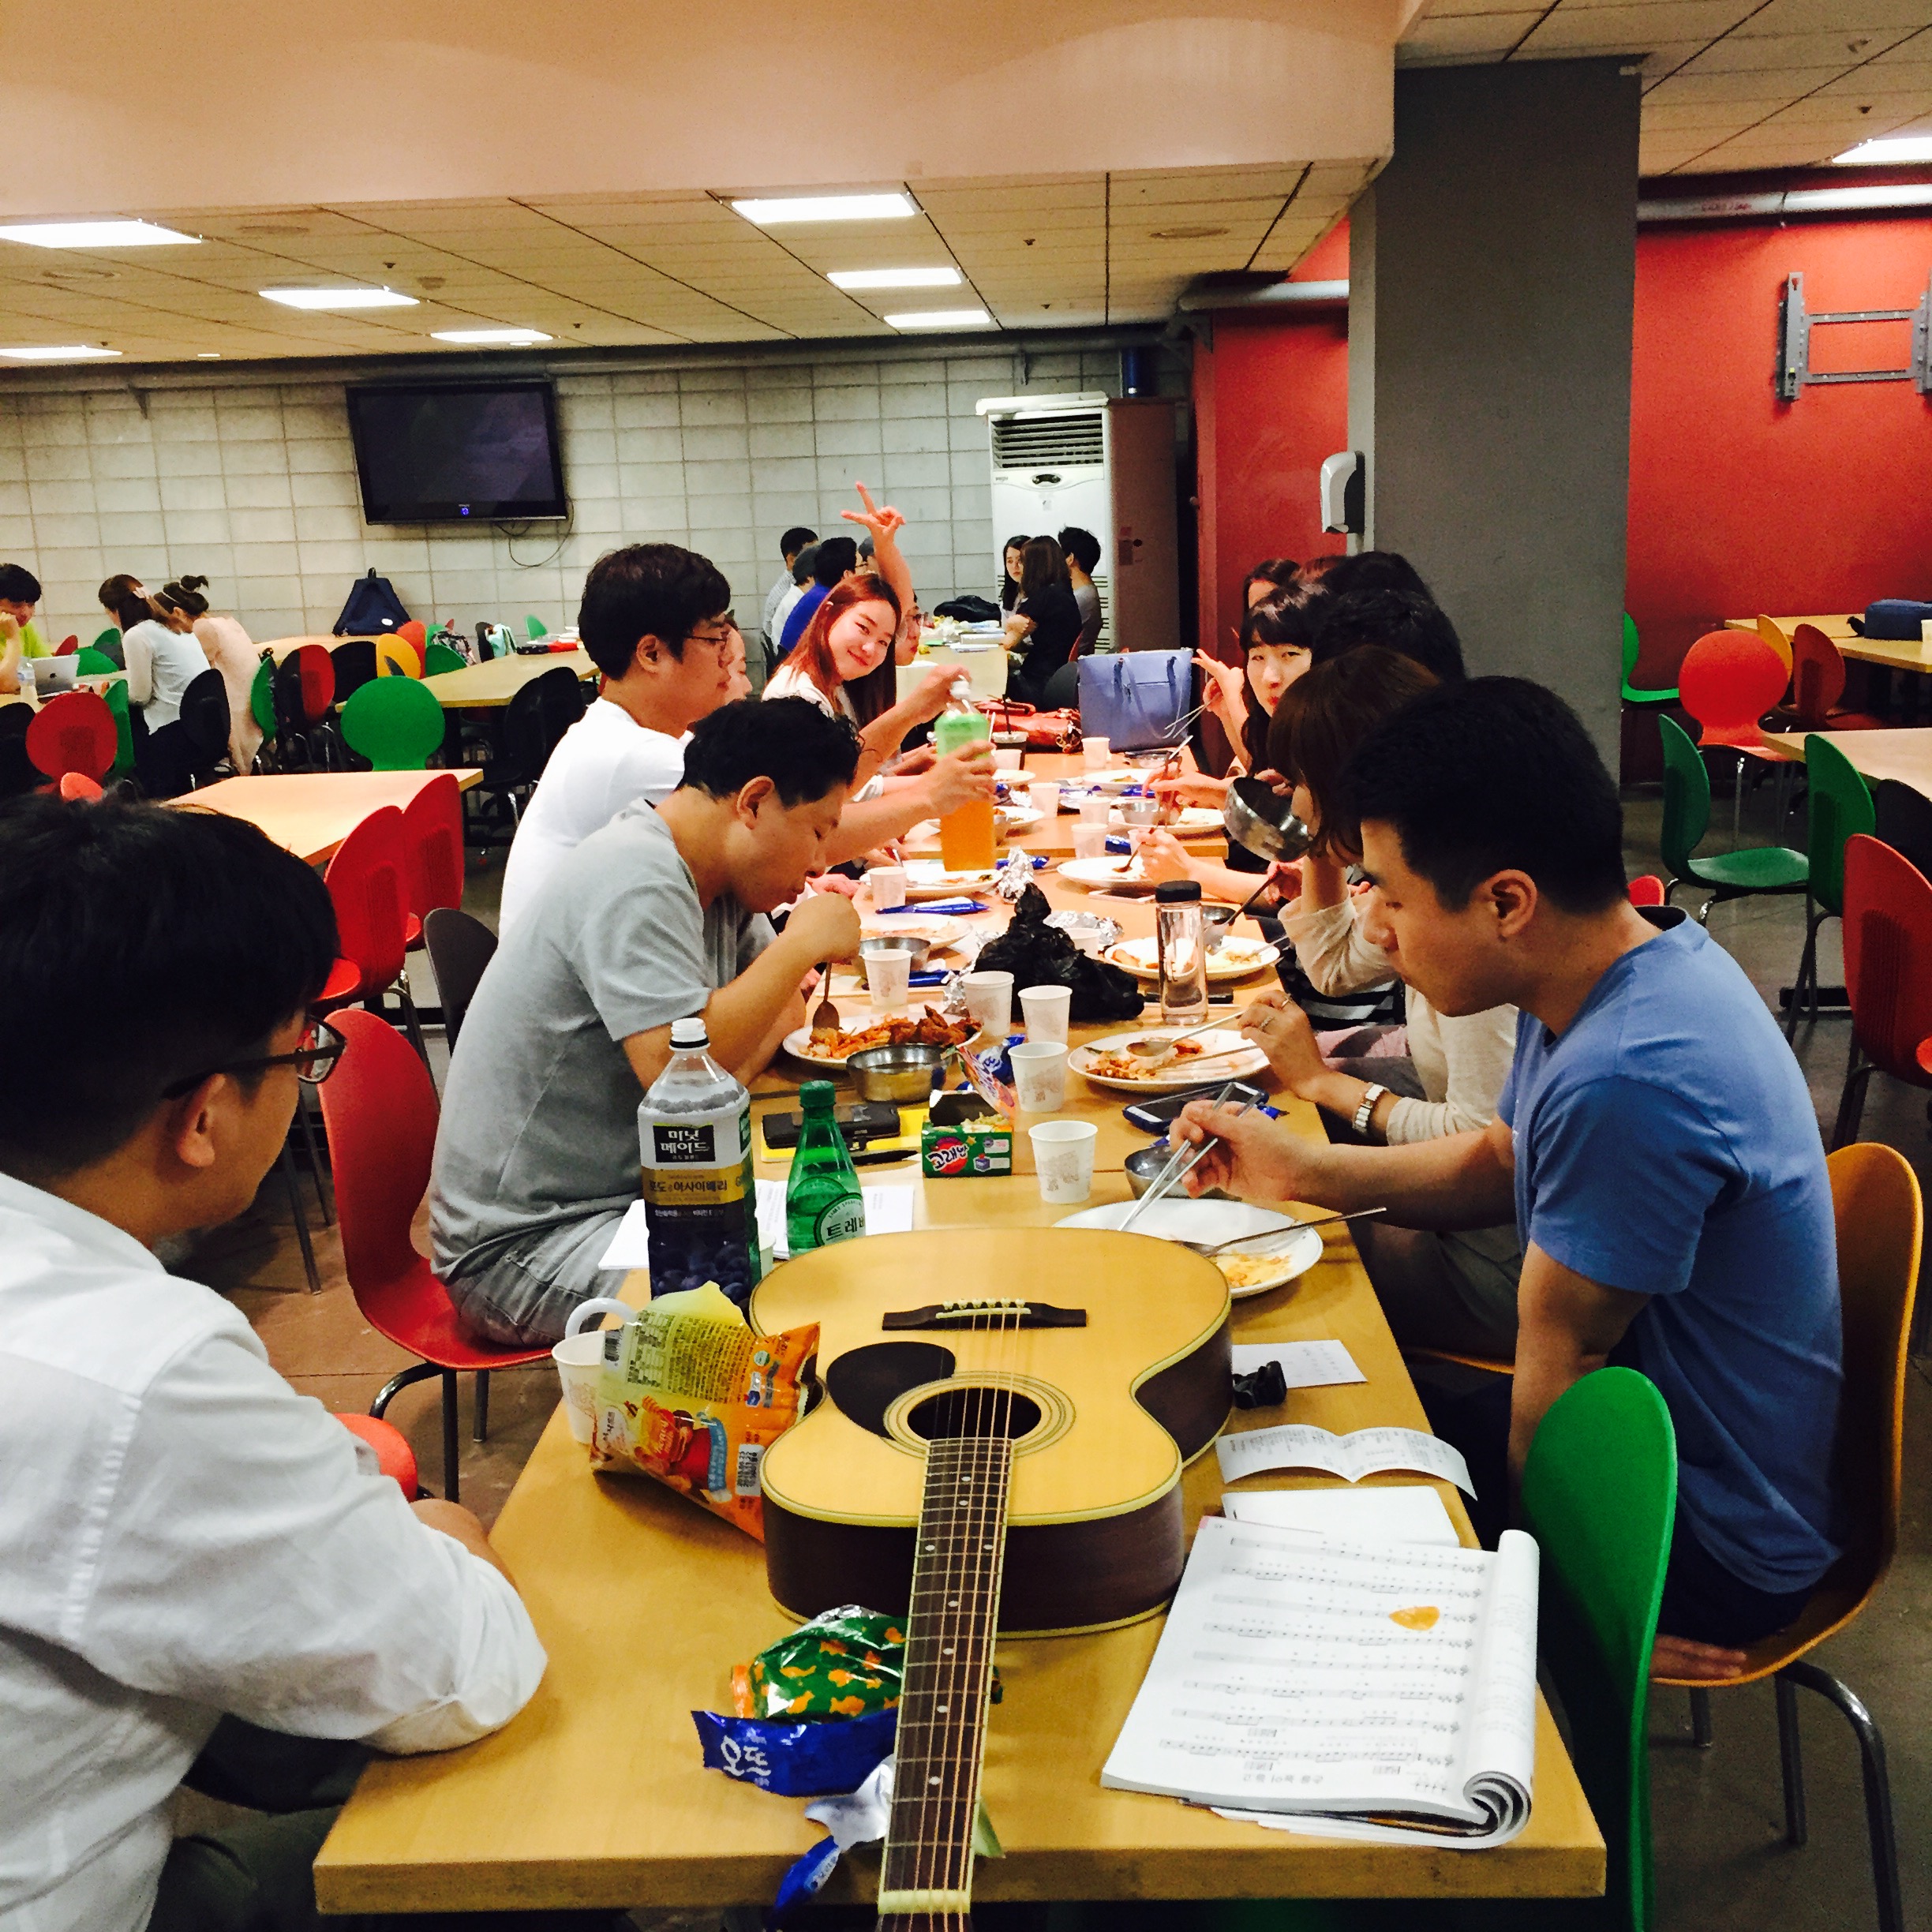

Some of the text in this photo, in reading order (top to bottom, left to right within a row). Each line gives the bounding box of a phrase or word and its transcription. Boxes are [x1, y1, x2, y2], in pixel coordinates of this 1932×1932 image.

[668, 1129, 700, 1142] 미닛
[661, 1141, 710, 1154] 메이드
[720, 1734, 772, 1777] 오뜨
